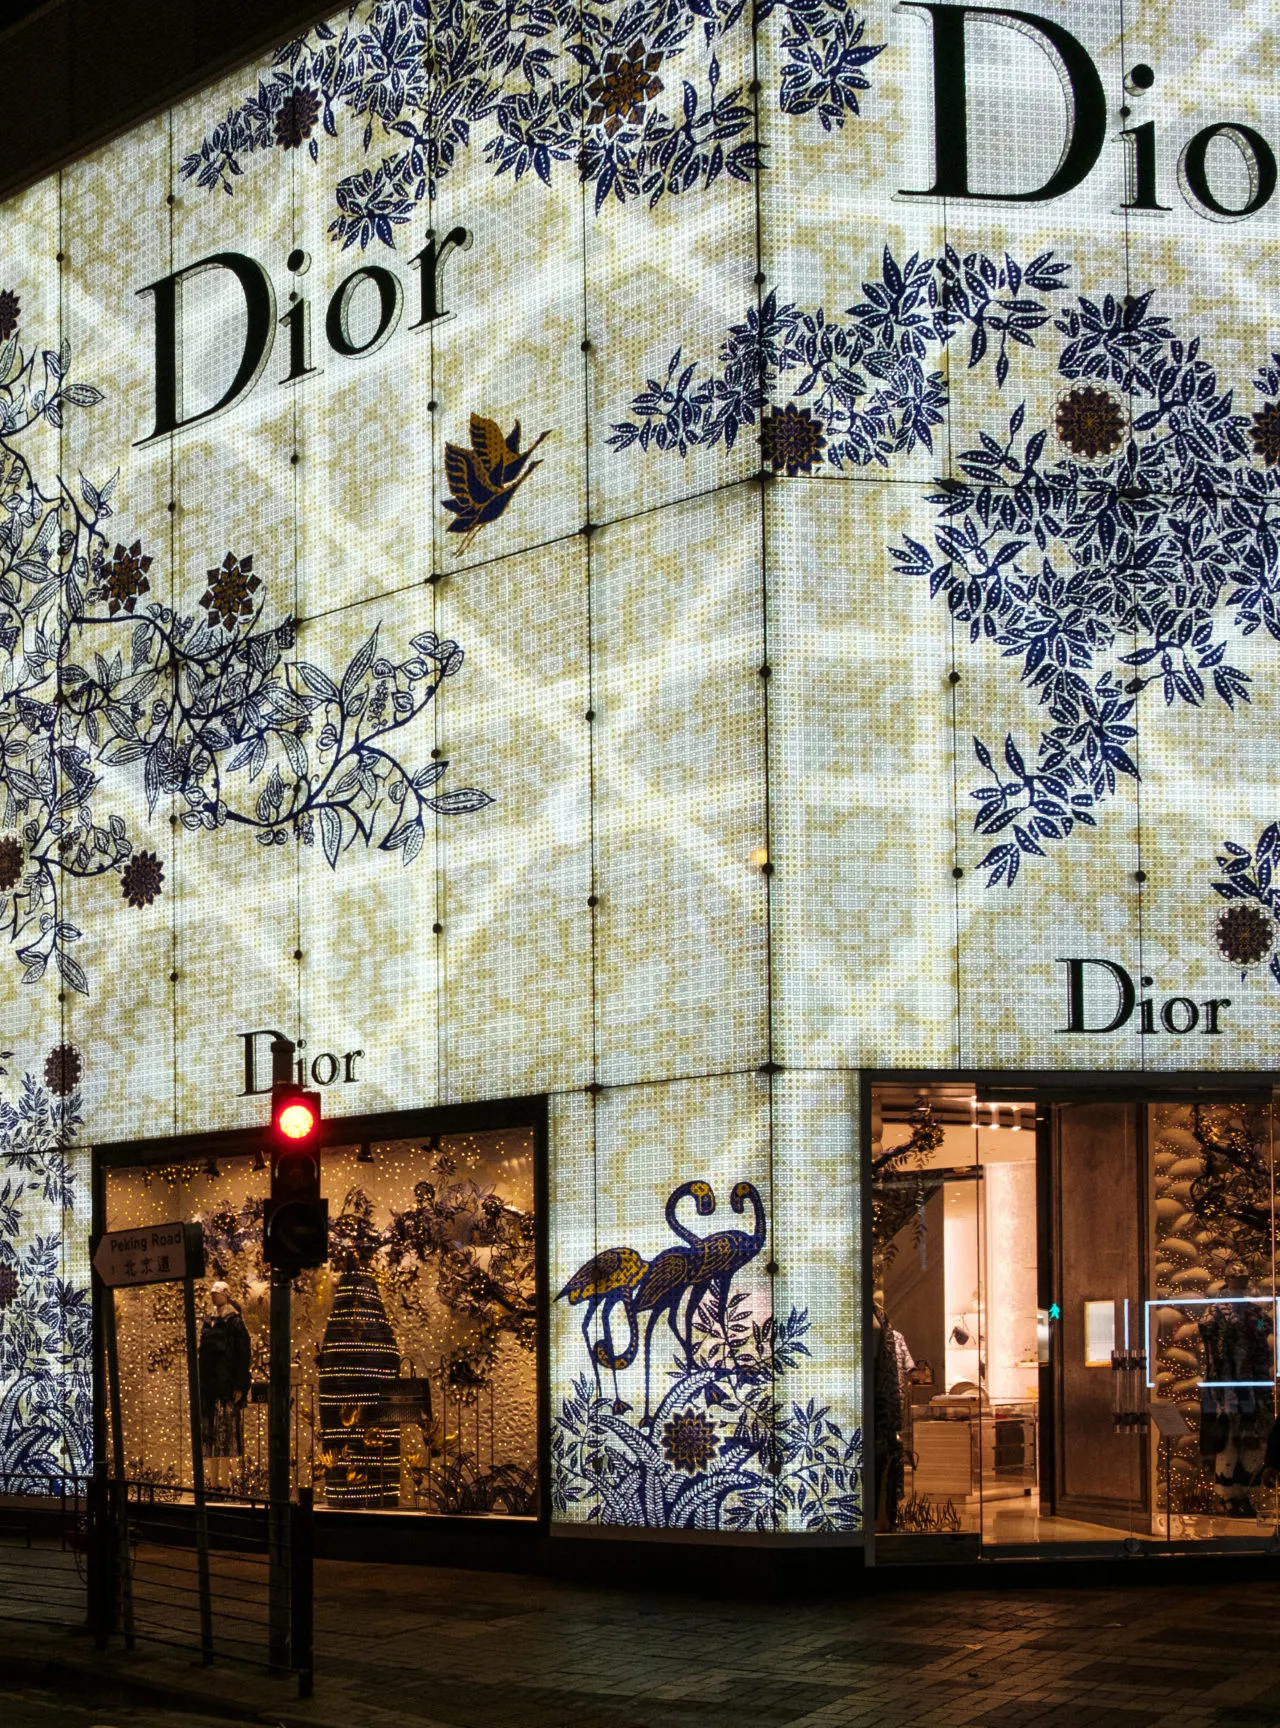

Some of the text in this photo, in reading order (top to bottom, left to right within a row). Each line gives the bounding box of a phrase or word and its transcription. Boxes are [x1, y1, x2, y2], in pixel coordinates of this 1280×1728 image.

[132, 226, 473, 449] Dior
[1055, 958, 1232, 1035] Dior
[236, 1030, 365, 1097] Dior
[110, 1230, 182, 1253] Peking Road
[124, 1255, 171, 1277] 北京道
